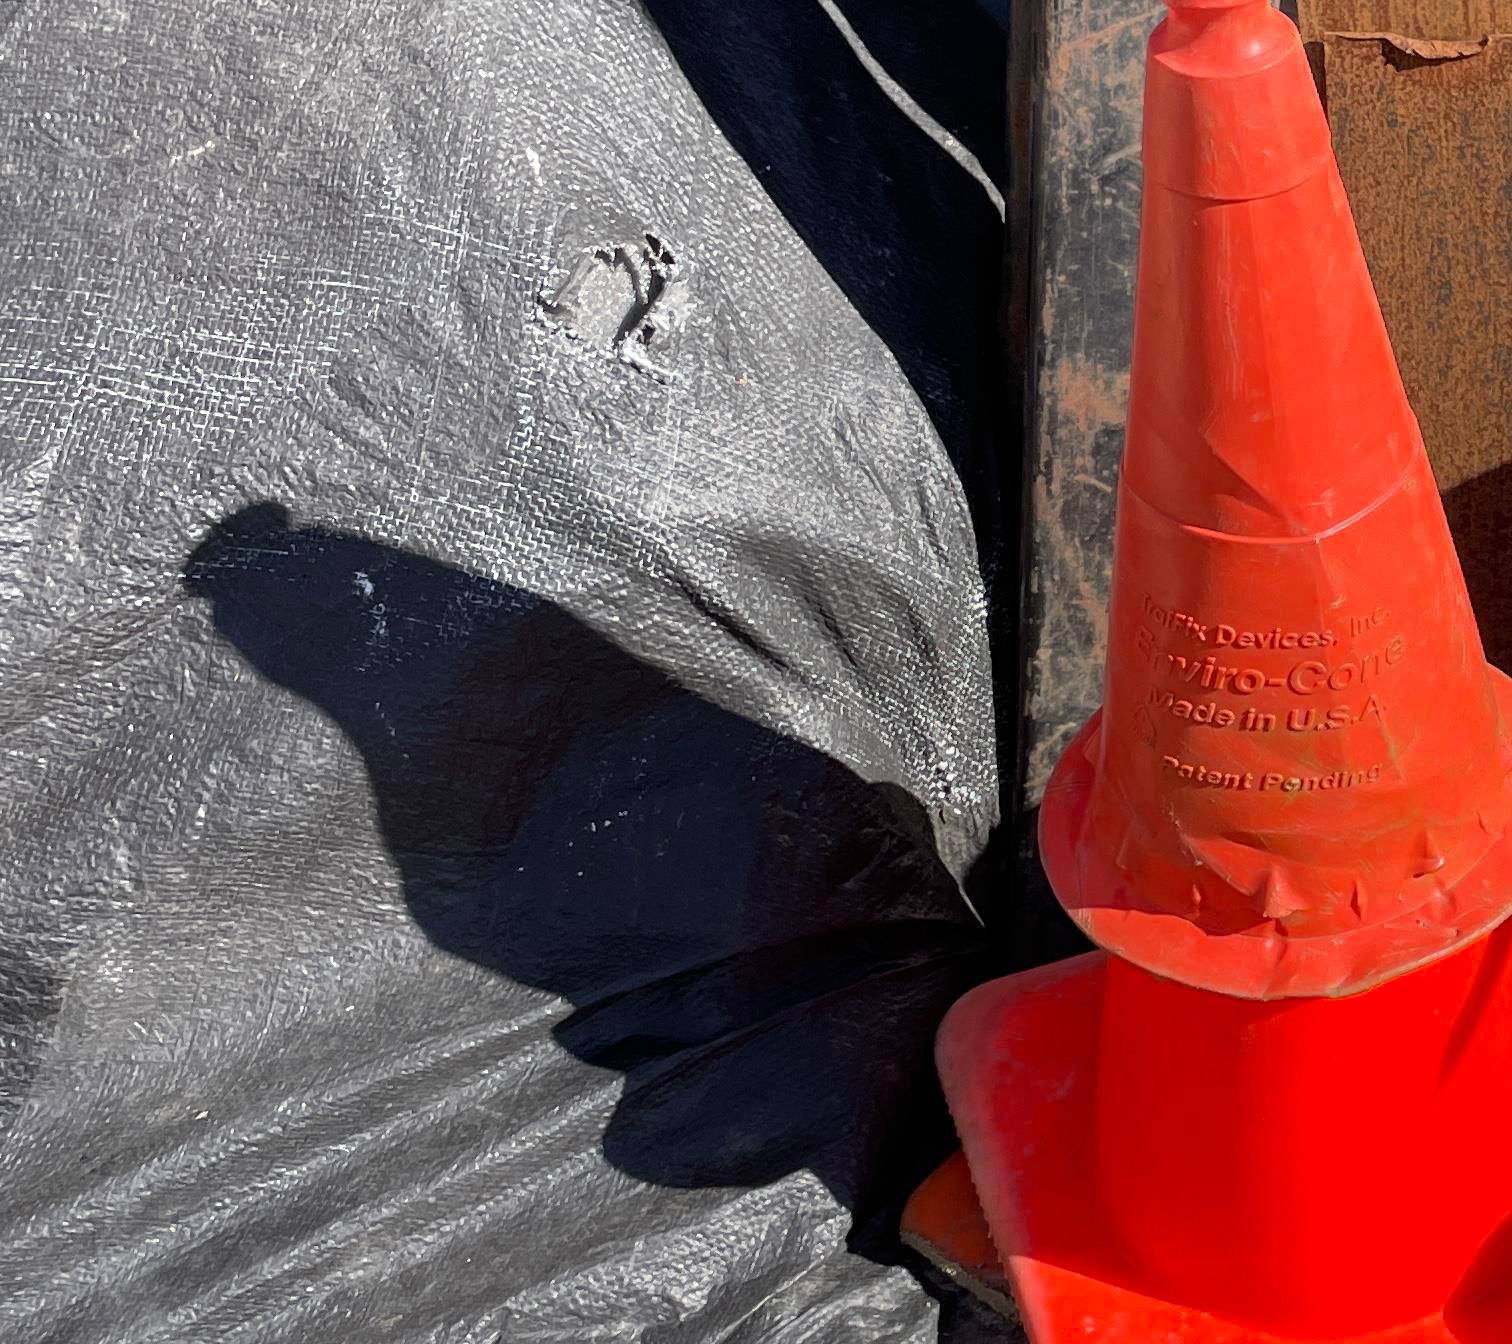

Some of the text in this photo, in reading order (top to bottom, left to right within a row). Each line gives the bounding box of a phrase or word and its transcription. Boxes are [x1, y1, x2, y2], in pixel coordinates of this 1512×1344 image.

[1349, 606, 1390, 638] Inc.
[1149, 686, 1236, 729] Made
[1240, 707, 1276, 732] in
[1161, 754, 1382, 793] Patent Pending
